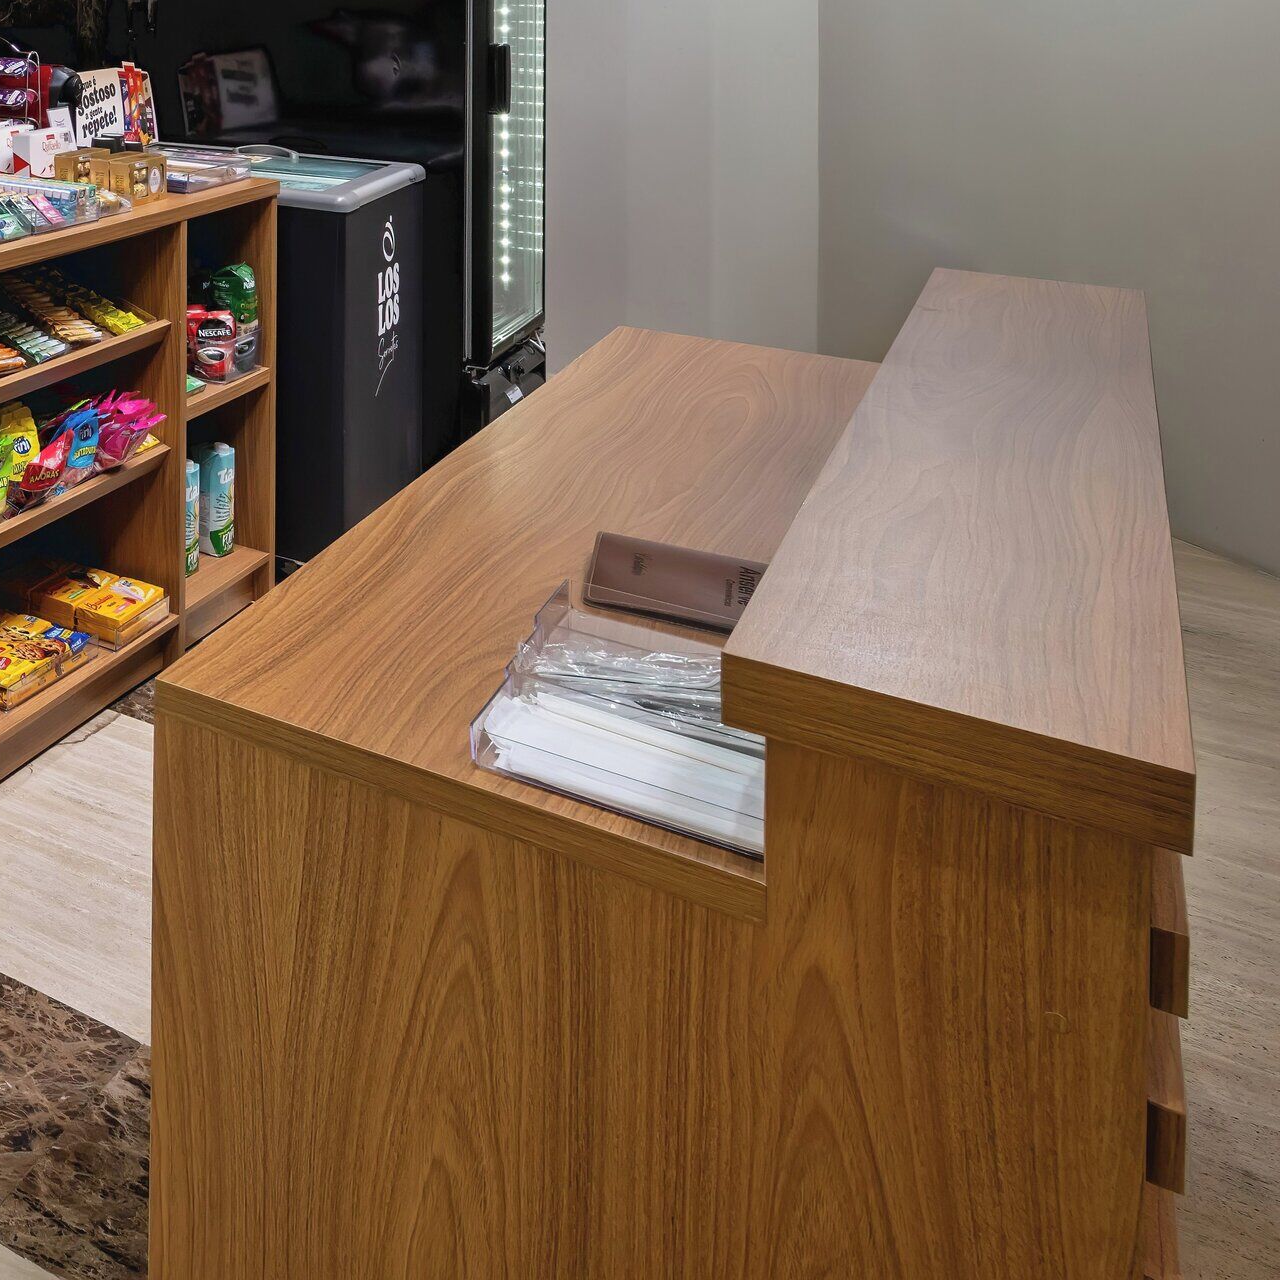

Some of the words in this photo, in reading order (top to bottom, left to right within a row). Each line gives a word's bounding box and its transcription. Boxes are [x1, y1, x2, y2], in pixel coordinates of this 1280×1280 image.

[82, 106, 118, 138] repete!
[90, 106, 103, 121] gente
[377, 261, 400, 304] LOS
[377, 293, 400, 337] LOS
[29, 469, 60, 485] AMORAS
